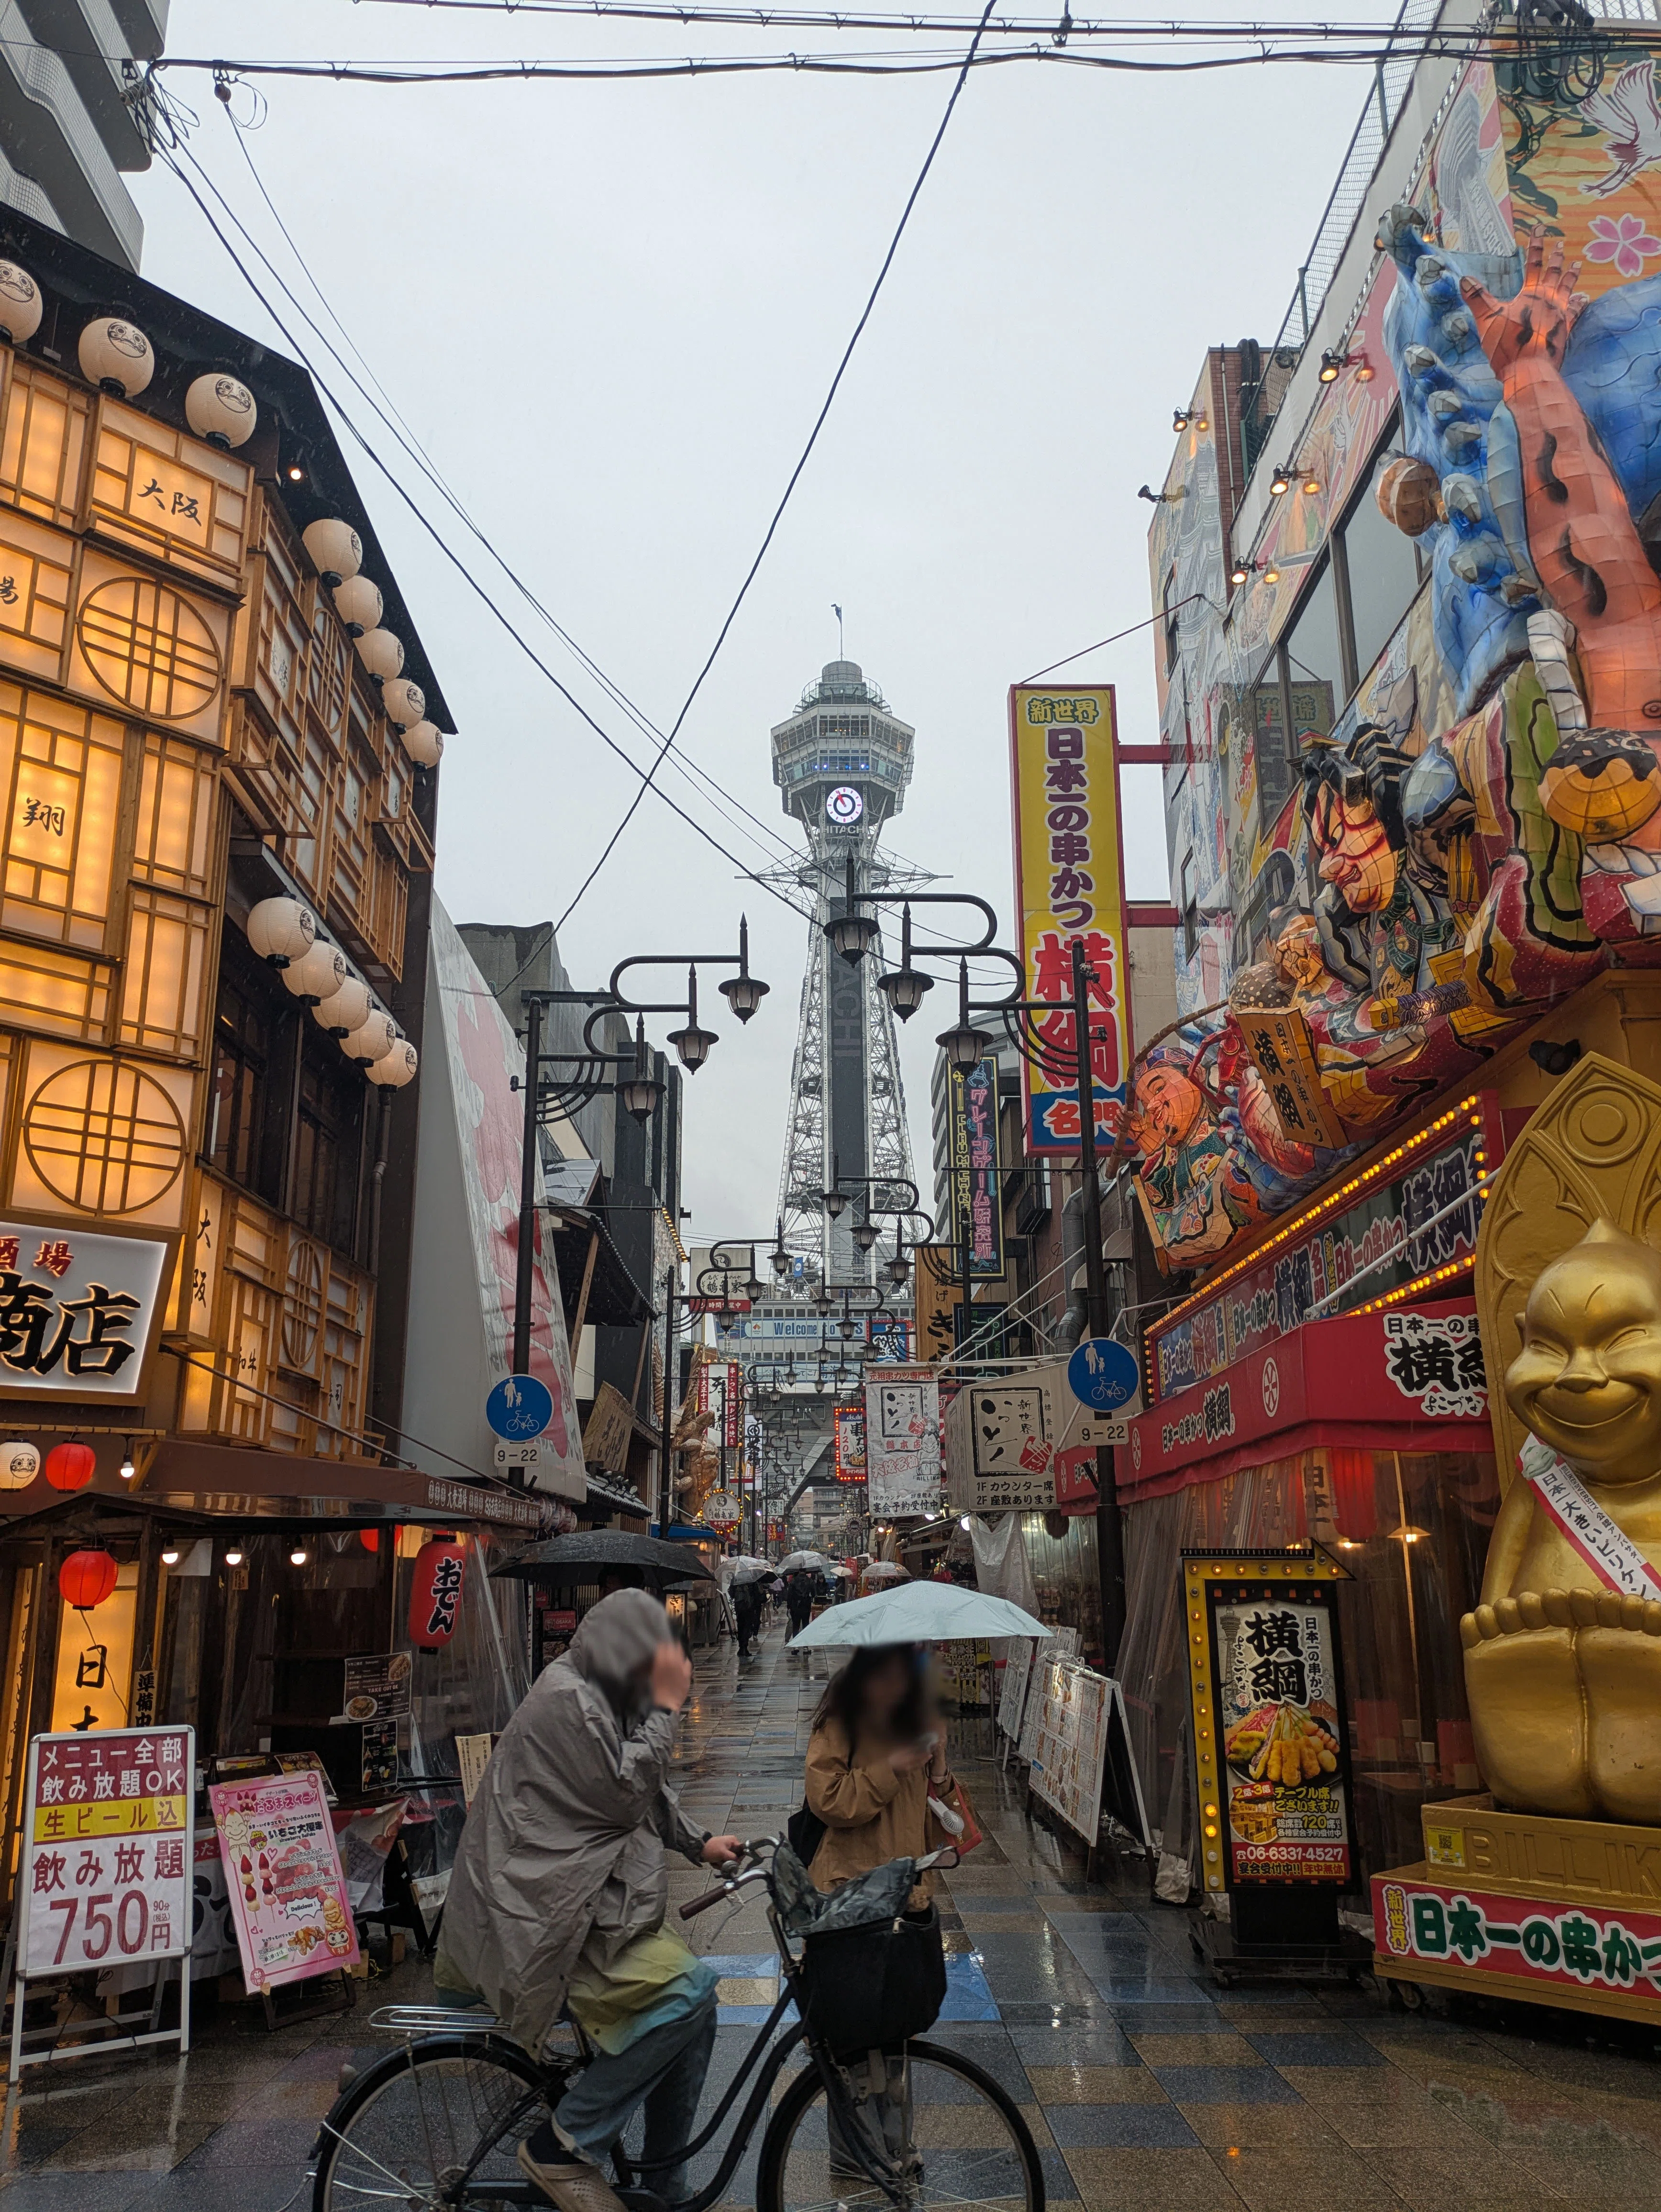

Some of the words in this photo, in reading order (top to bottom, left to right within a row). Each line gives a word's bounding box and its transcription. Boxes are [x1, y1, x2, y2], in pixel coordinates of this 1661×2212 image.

[137, 479, 202, 527] 大阪
[1027, 697, 1099, 725] 新世界
[22, 797, 65, 836] 翔
[821, 825, 868, 834] HITACHI
[1046, 728, 1094, 929] 日本一の串かつ
[1035, 932, 1120, 1088] 横綱
[1250, 1028, 1306, 1130] 横綱
[1273, 1021, 1324, 1142] 日本一の串かつ
[970, 1088, 993, 1259] クレーンゲーム研究所
[191, 1208, 211, 1308] 大阪
[774, 1322, 817, 1335] Welcome
[869, 1371, 934, 1381] 元祖串カツ専門店
[1017, 1399, 1035, 1435] 新世界
[1043, 1389, 1054, 1440] 商標登録
[1163, 1413, 1203, 1453] 日本一の串かつ
[1203, 1382, 1231, 1444] 横綱
[886, 1439, 922, 1450] 総本店
[872, 1454, 919, 1479] 大阪名物
[872, 1499, 939, 1514] 宴会予約受付中
[1542, 1472, 1654, 1600] 日本一大きいビリケン
[428, 1557, 463, 1635] おでん
[1244, 1610, 1307, 1705] 横綱
[1305, 1616, 1322, 1698] 日本一の串かつ
[135, 1673, 156, 1727] 準備中
[42, 1736, 182, 1771] メニュー全部
[42, 1768, 182, 1804] 飲み放題OK
[254, 1791, 319, 1814] だるまスイーツ
[1274, 1786, 1330, 1800] テーブル席
[43, 1800, 178, 1838] 生ビール込
[32, 1838, 184, 1894] 飲み放題
[1247, 1846, 1343, 1861] 06-6331-4527
[1303, 1863, 1344, 1875] 年中無休
[153, 1900, 170, 1912] 90分
[153, 1913, 170, 1922] (税込)
[1386, 1890, 1409, 1951] 新世界
[49, 1889, 148, 1965] 750
[151, 1923, 171, 1951] 円
